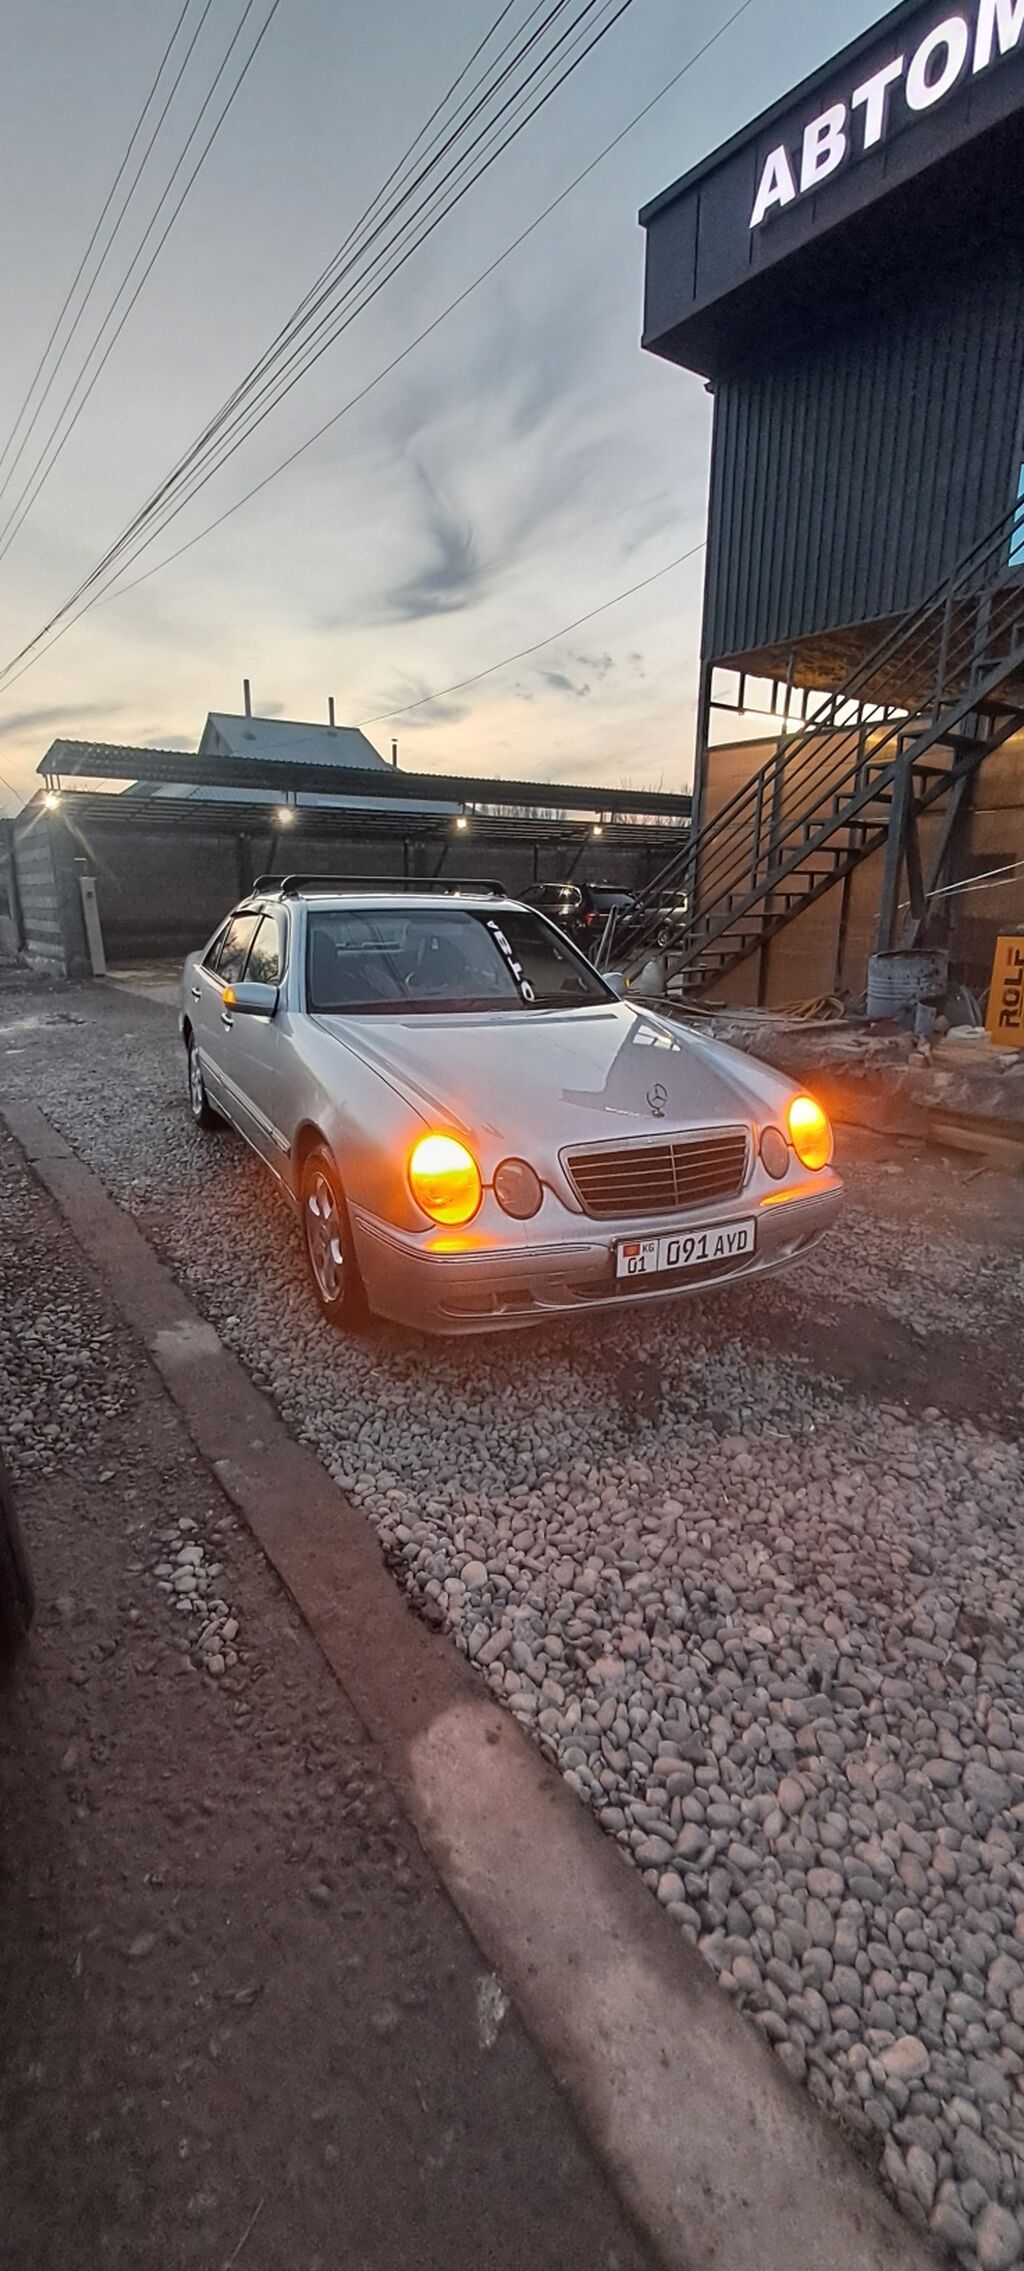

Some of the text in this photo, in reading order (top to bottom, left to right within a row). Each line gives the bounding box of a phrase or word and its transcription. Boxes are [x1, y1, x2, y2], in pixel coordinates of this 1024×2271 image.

[642, 1242, 654, 1252] KG
[667, 1230, 747, 1266] 091 AYD
[628, 1256, 646, 1274] 01
